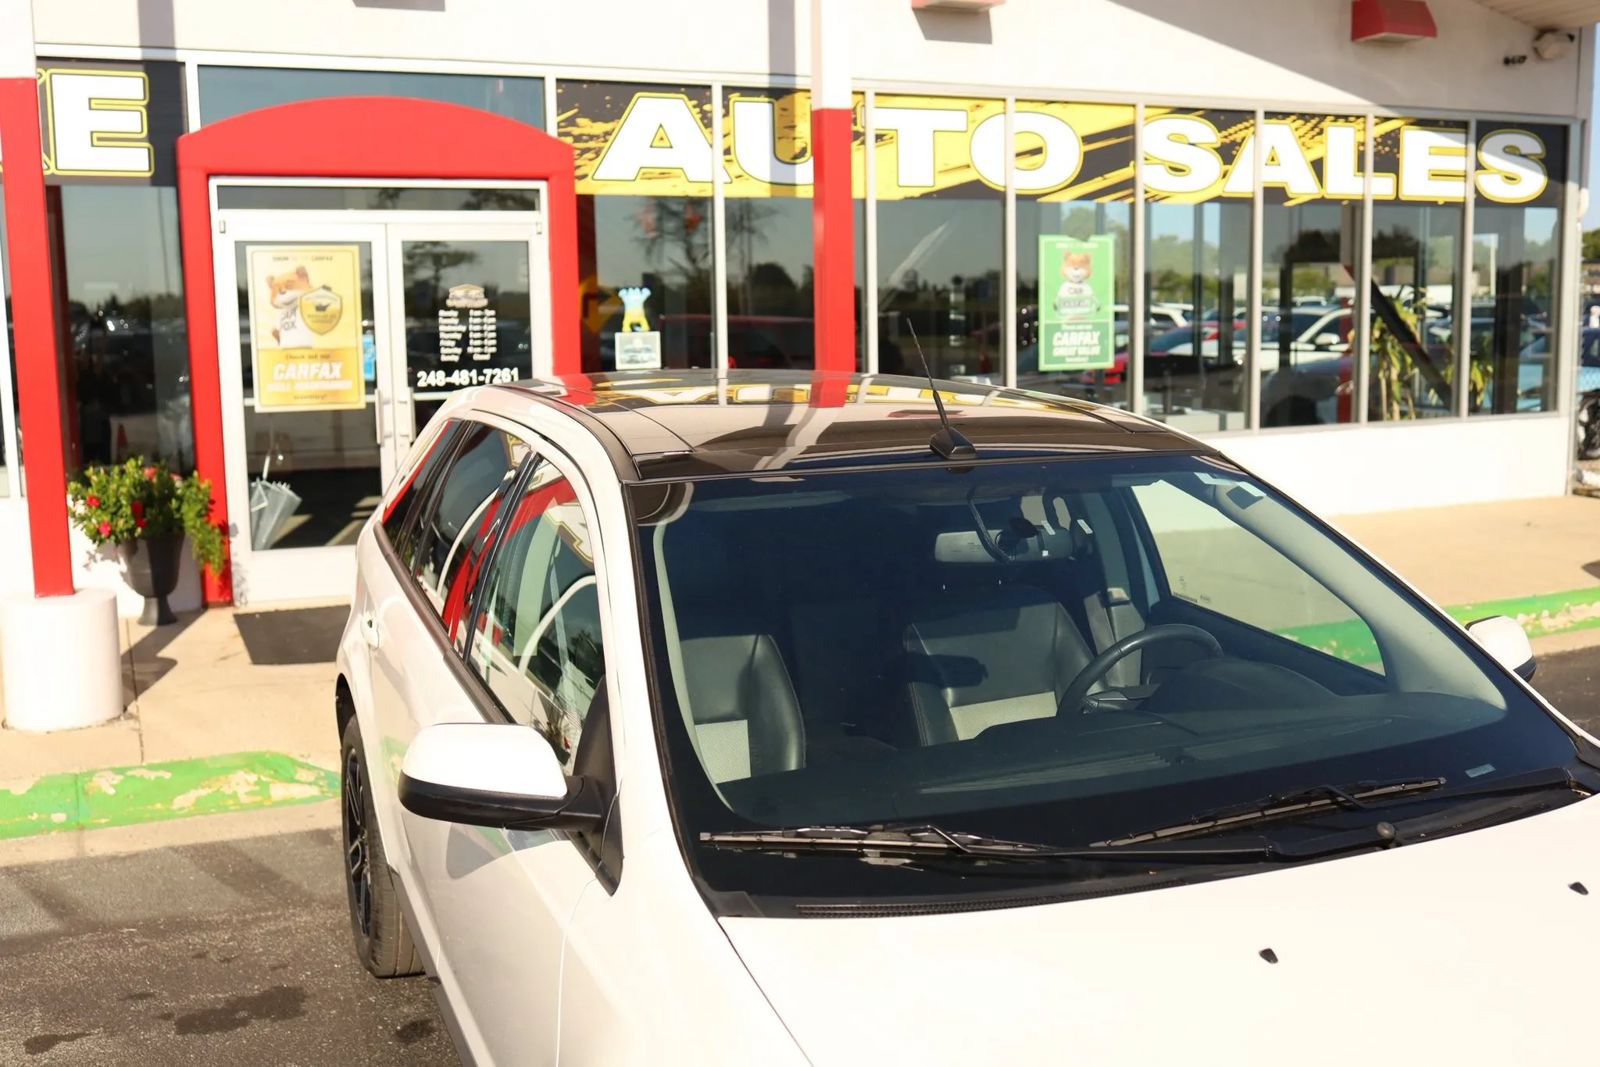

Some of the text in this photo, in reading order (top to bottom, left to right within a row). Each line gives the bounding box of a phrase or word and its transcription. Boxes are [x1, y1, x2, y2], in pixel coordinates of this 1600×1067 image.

[37, 68, 155, 178] E
[591, 91, 1548, 204] AUTO SALES
[272, 361, 343, 380] CARFAX
[1052, 331, 1101, 346] CARFAX
